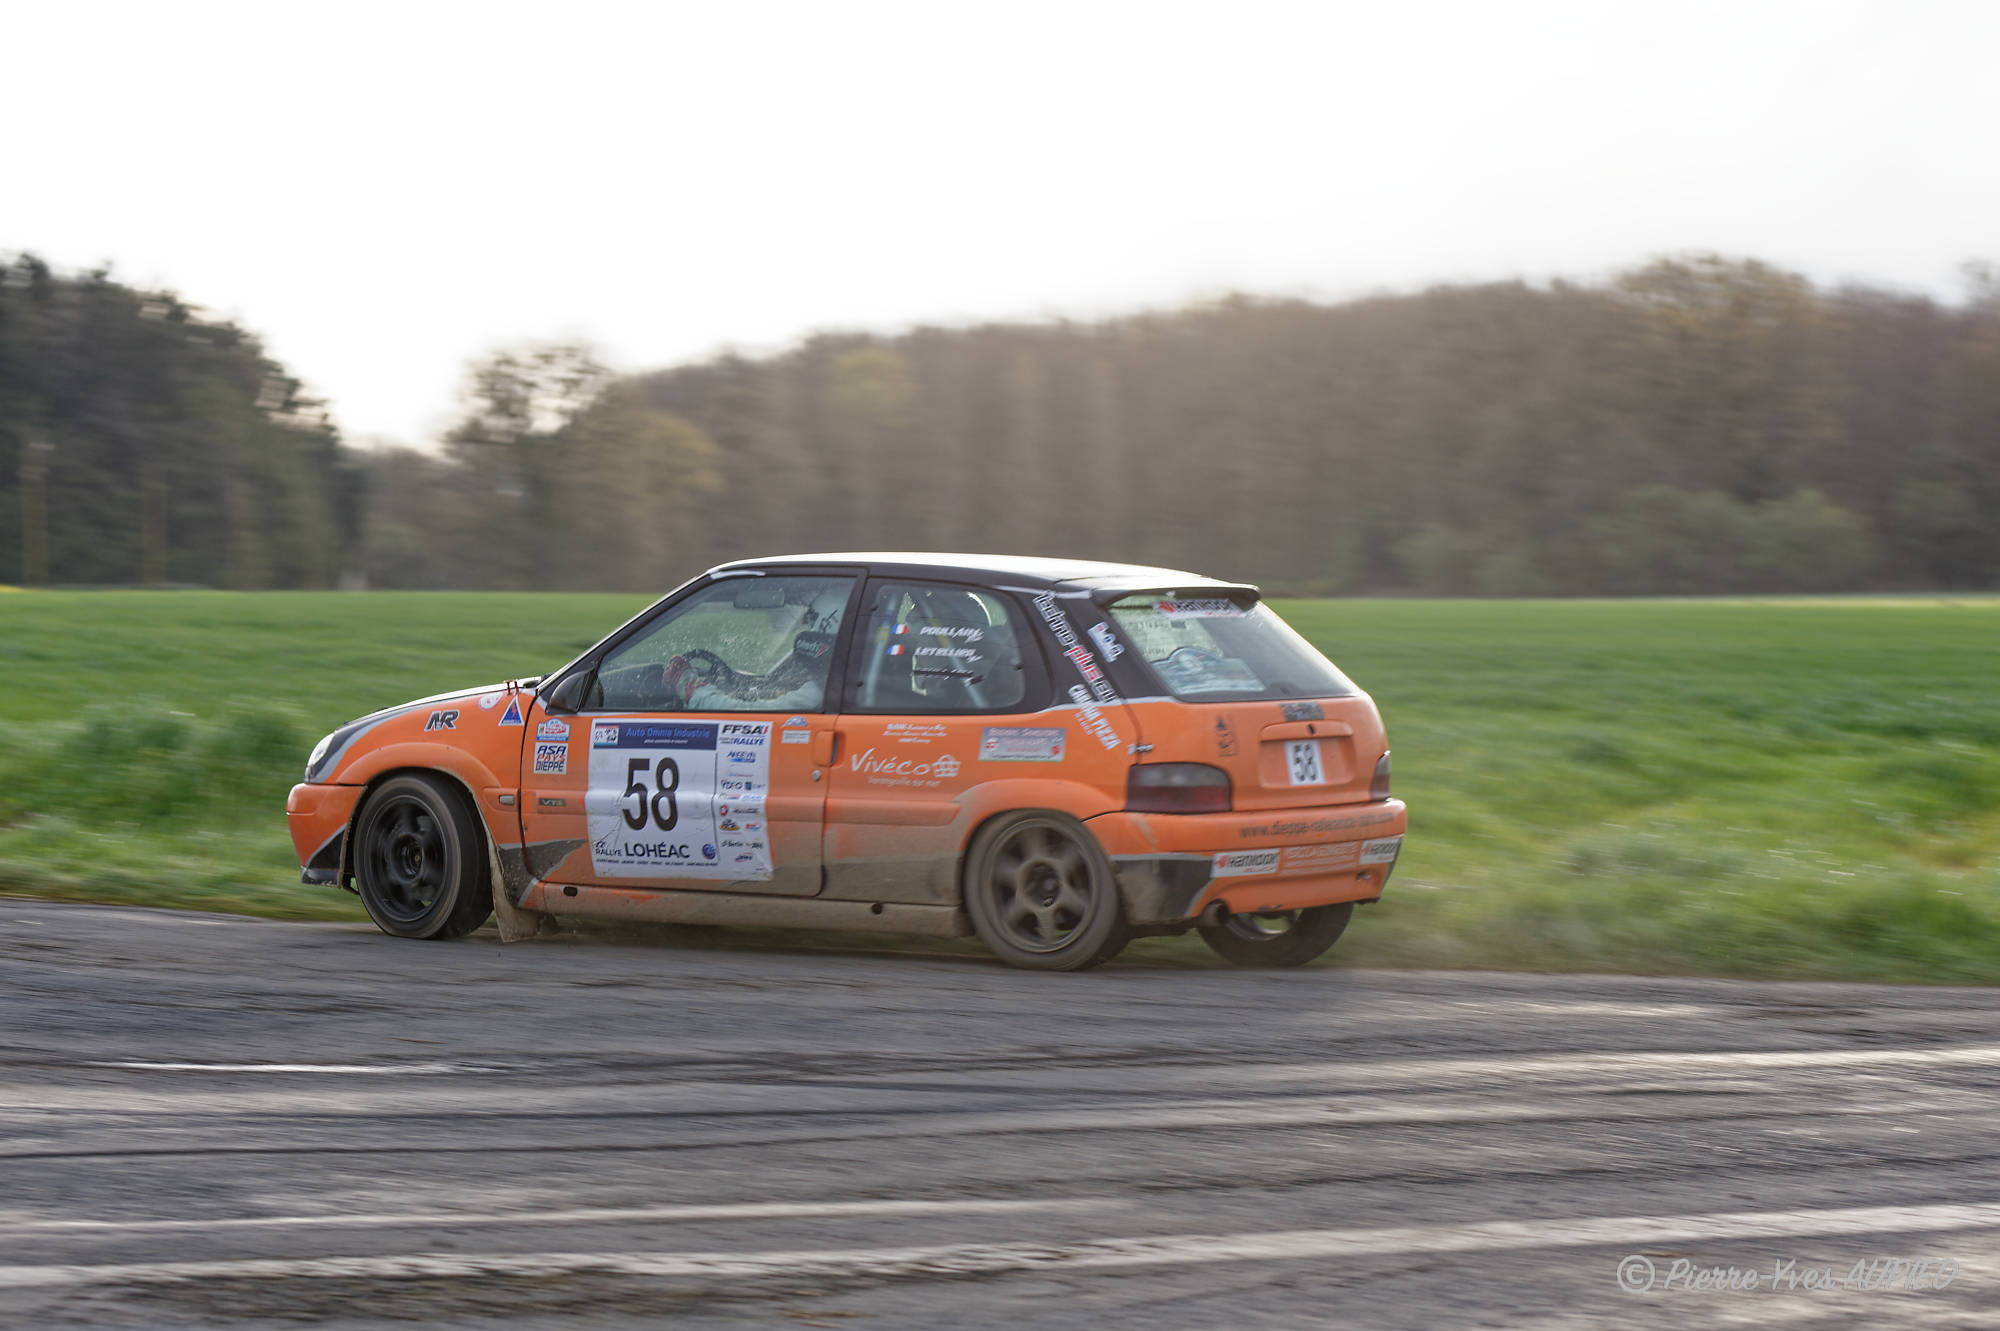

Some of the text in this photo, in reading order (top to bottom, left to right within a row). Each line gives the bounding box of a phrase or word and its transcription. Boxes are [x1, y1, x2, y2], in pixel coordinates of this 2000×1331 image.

[722, 724, 764, 735] FFSA
[733, 738, 766, 746] RALLYE
[538, 745, 567, 754] ASA
[537, 754, 565, 762] PAYS
[535, 761, 565, 772] DIEPPE
[622, 757, 680, 832] 58
[595, 842, 691, 859] RALLYE LOHÉAC
